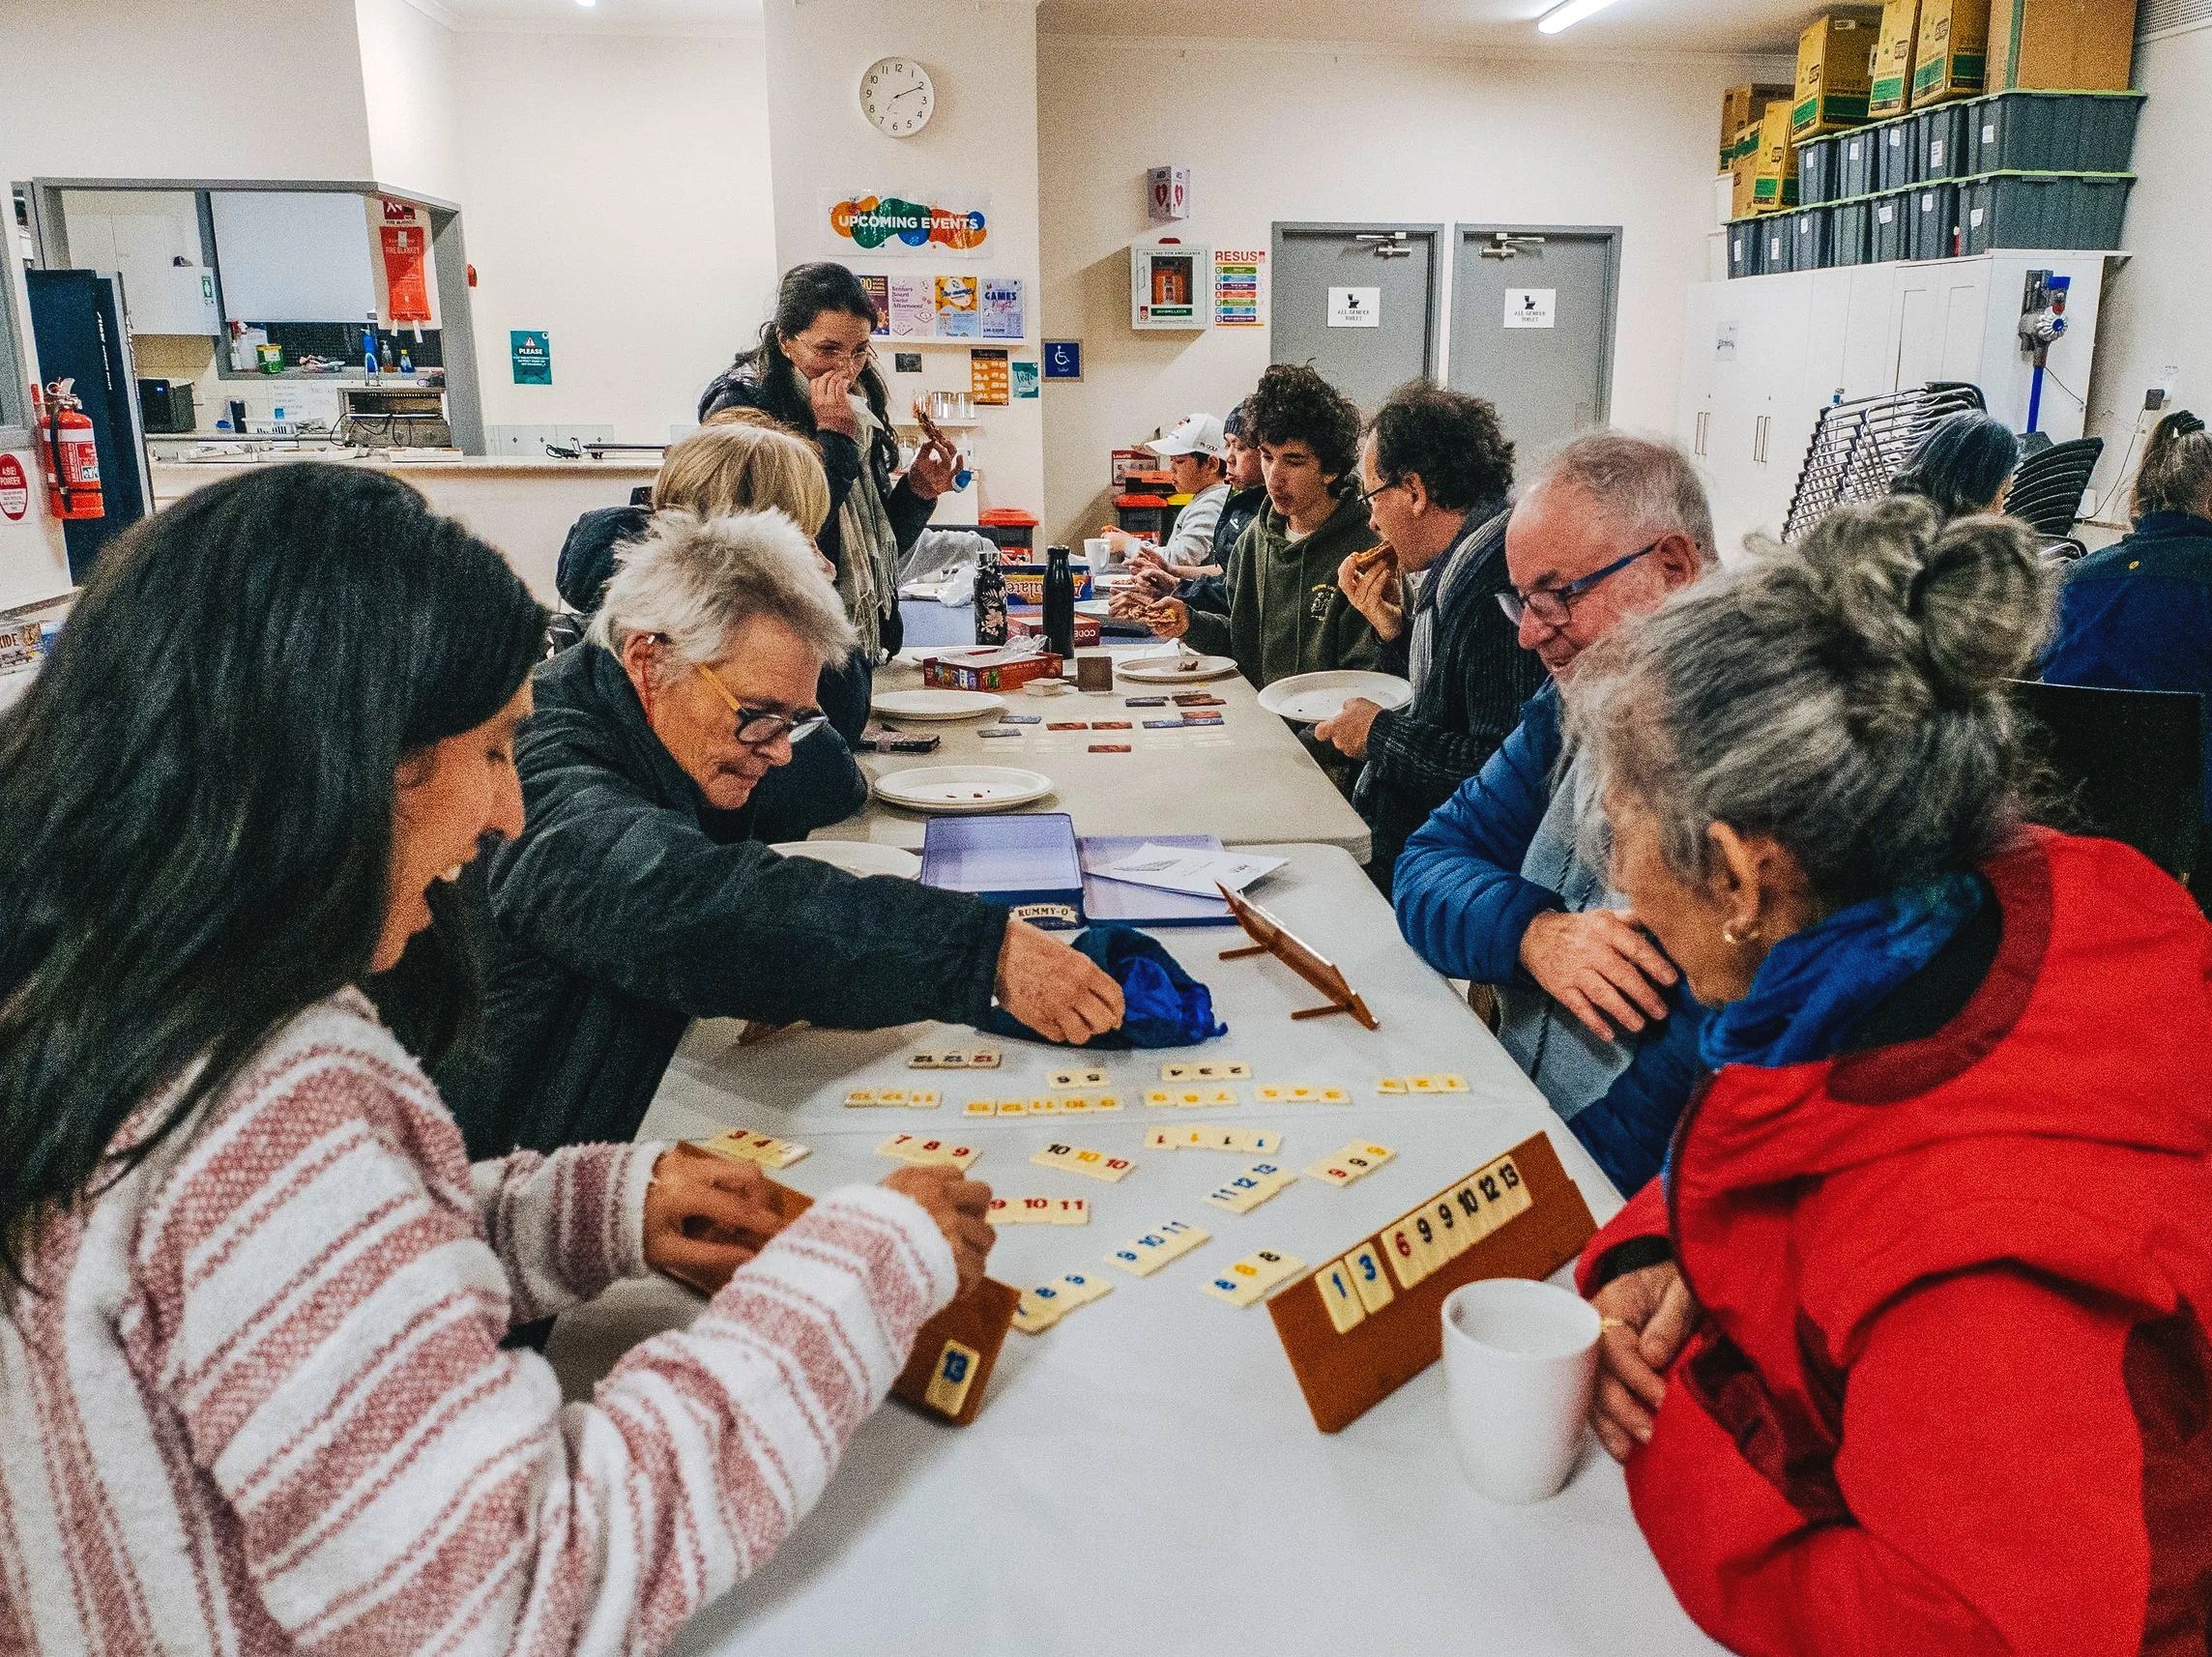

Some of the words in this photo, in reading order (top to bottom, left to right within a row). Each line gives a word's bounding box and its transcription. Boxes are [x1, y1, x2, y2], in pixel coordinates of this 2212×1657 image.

[882, 66, 888, 74] 11
[895, 64, 903, 73] 12
[870, 75, 878, 84] 10
[918, 81, 924, 90] 2
[866, 89, 872, 98] 9
[869, 104, 875, 113] 8
[892, 122, 898, 131] 6
[906, 120, 912, 129] 5
[838, 216, 917, 229] UPCOMING
[921, 218, 978, 230] EVENTS
[1214, 251, 1257, 262] RESUS
[984, 292, 1017, 301] GAMES
[1018, 908, 1069, 917] RUMMY-O
[727, 1129, 748, 1140] 3
[894, 1134, 913, 1145] 7
[922, 1140, 942, 1150] 8
[951, 1147, 970, 1157] 9
[1047, 1144, 1071, 1155] 10
[1076, 1149, 1101, 1162] 10
[1105, 1157, 1129, 1170] 10
[1211, 1188, 1238, 1201] 11
[1232, 1177, 1259, 1189] 12
[1023, 1198, 1048, 1209] 10
[1060, 1200, 1084, 1211] 11
[1332, 1272, 1347, 1299] 1
[1357, 1253, 1377, 1282] 3
[1395, 1231, 1412, 1257] 6
[1416, 1217, 1433, 1243] 9
[1438, 1203, 1454, 1229] 9
[1457, 1187, 1479, 1217] 10
[1478, 1175, 1500, 1203] 12
[1499, 1163, 1520, 1190] 13
[943, 1350, 969, 1384] 13
